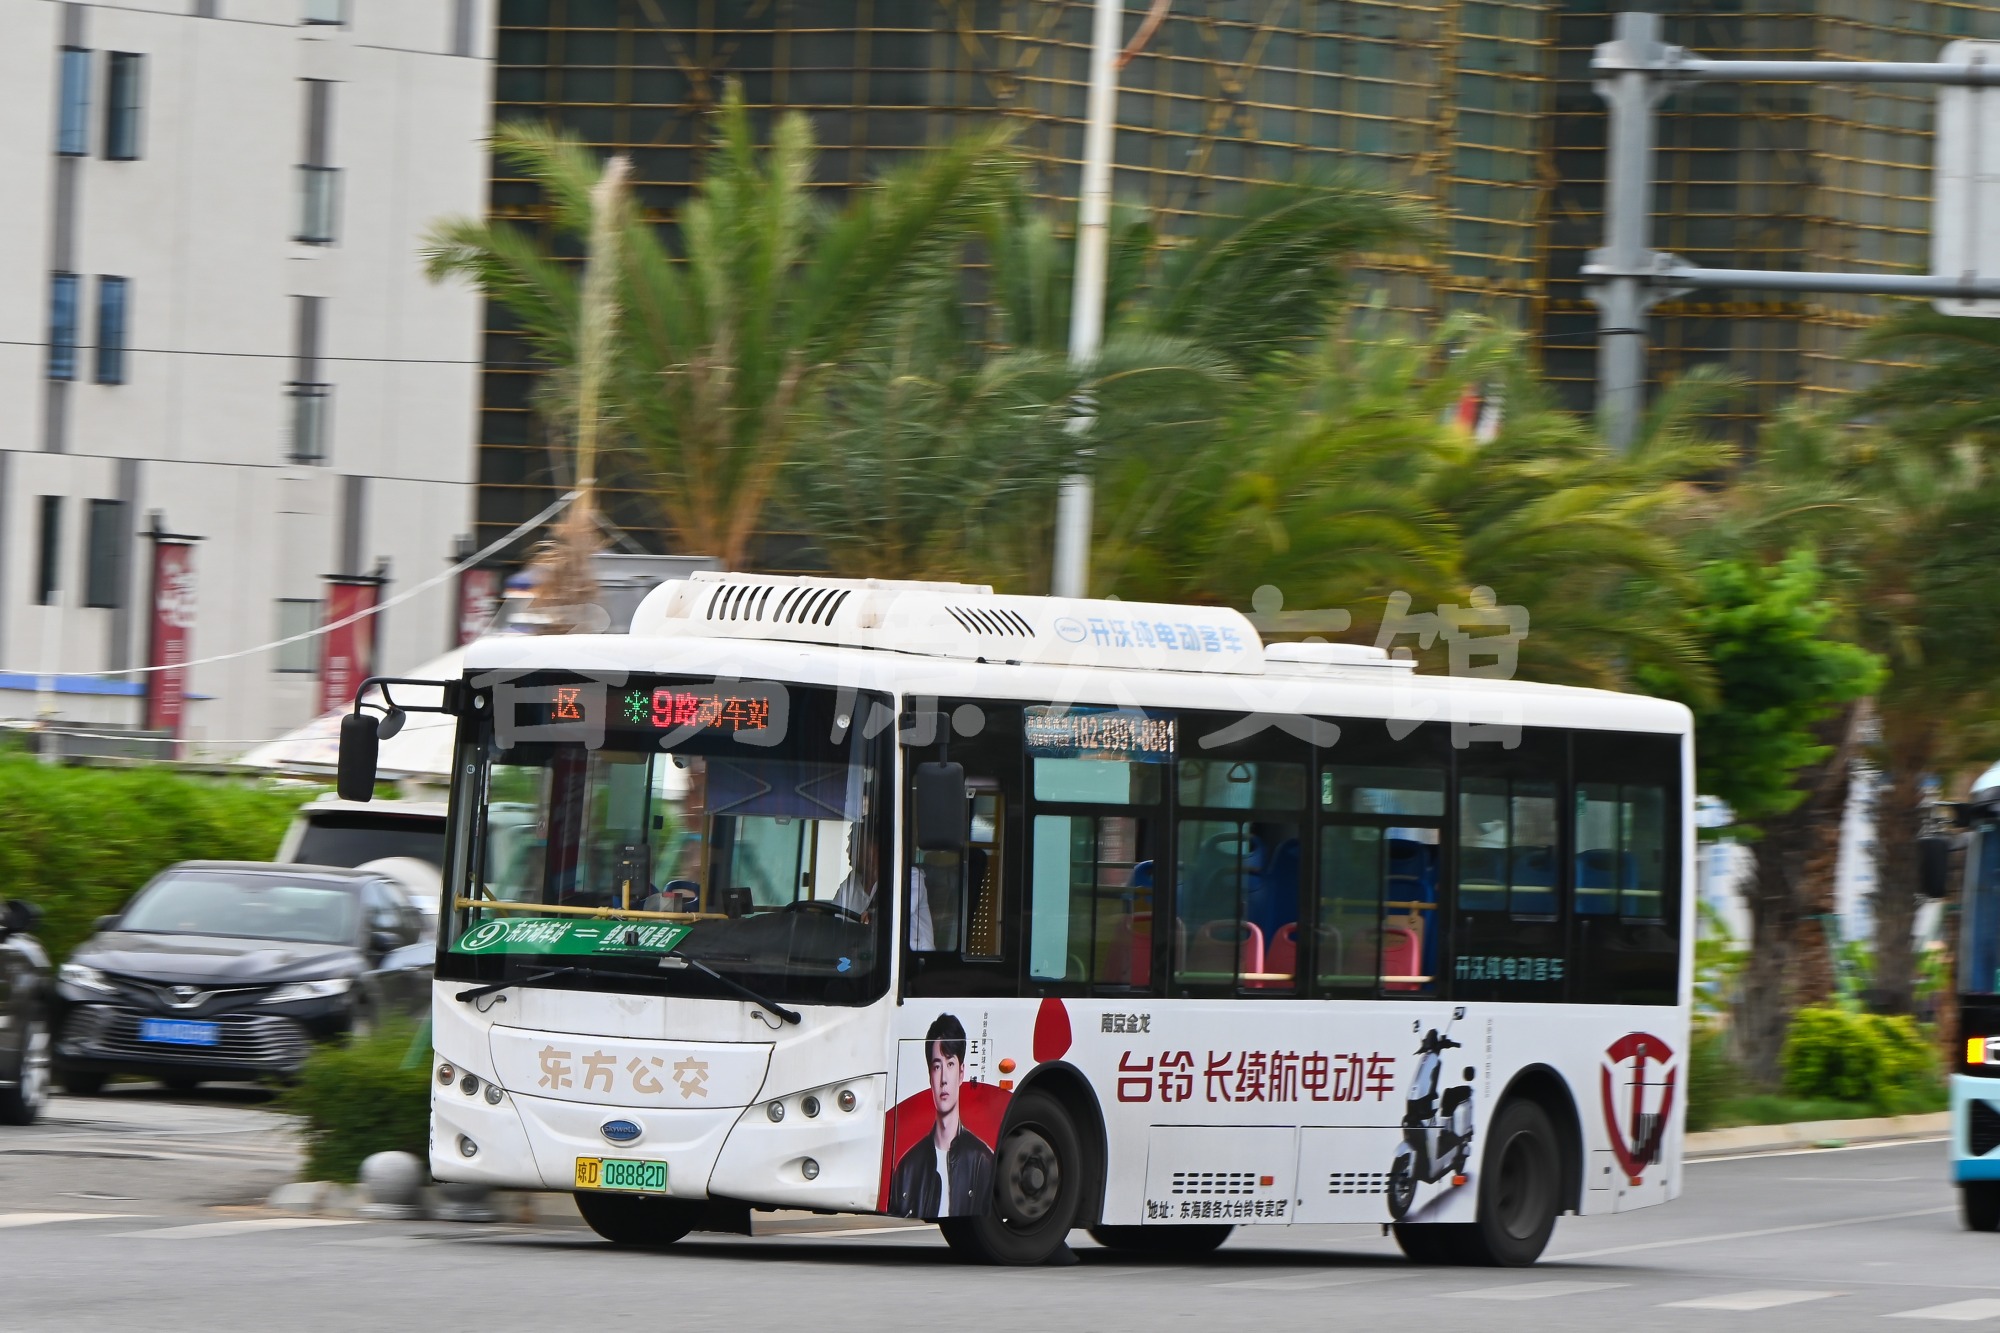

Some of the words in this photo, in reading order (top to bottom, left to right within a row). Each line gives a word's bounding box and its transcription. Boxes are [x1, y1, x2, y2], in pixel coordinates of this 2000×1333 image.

[1088, 617, 1243, 653] 开沃纯电动客车
[468, 924, 500, 947] 9
[1455, 955, 1564, 981] 开沃纯电动客车
[1101, 1012, 1151, 1034] 南京金龙
[537, 1044, 710, 1100] 东方公交
